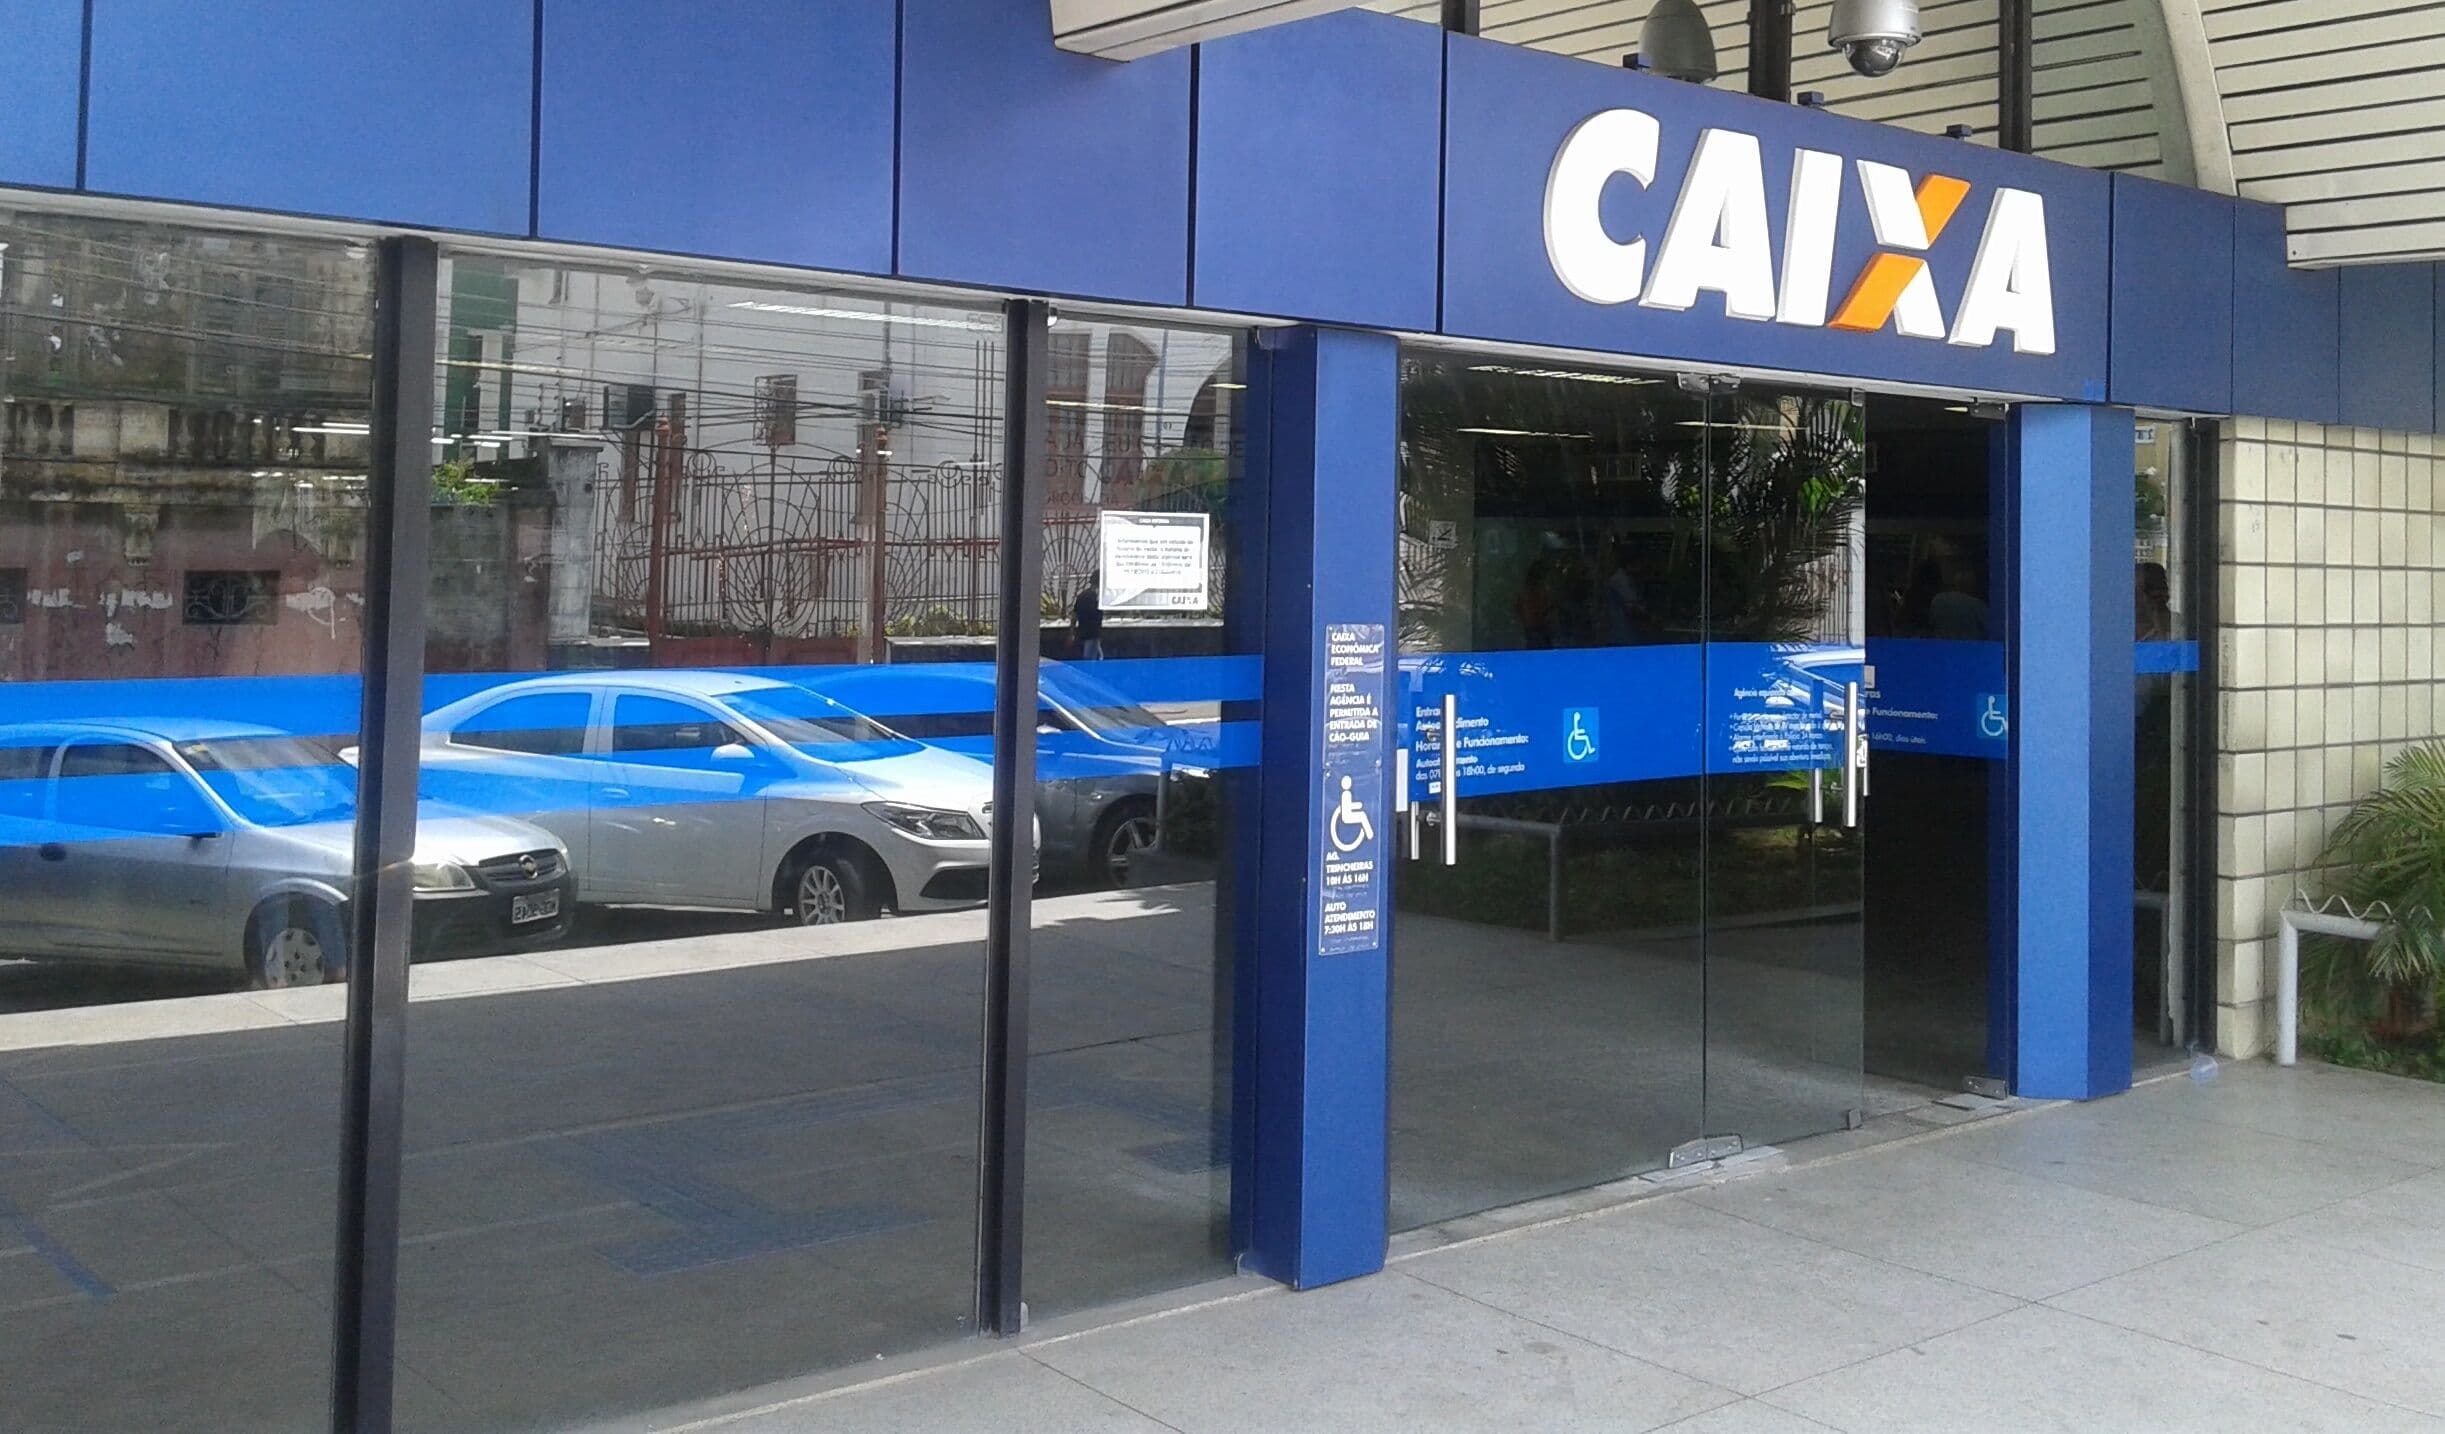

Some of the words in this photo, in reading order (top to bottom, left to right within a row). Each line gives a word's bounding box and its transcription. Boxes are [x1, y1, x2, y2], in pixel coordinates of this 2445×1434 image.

[1543, 108, 2055, 354] CAIXA
[1332, 632, 1356, 641] CAIXA
[1331, 642, 1379, 654] ECONÔMICA
[1331, 657, 1363, 666] FEDERAL
[1330, 684, 1355, 693] NESTA
[1330, 694, 1365, 706] AGÊNCIA
[1367, 692, 1372, 705] É
[1330, 708, 1370, 718] PERMITIDA
[1372, 707, 1379, 716] A
[1873, 707, 1939, 720] Funcionamento:
[1330, 720, 1365, 730] ENTRADA
[1367, 720, 1378, 729] DE
[1329, 731, 1370, 742] CÃO-GUIA
[1464, 733, 1529, 748] Funcionamento:
[1487, 764, 1496, 774] de
[1326, 851, 1340, 862] AG.
[1327, 861, 1374, 873] TRINCHEIRAS
[1327, 876, 1341, 887] 10H
[1355, 873, 1369, 883] 16H
[1325, 901, 1347, 913] AUTO
[1325, 910, 1376, 924] ATENDIMENTO
[1325, 924, 1346, 936] 7:30H
